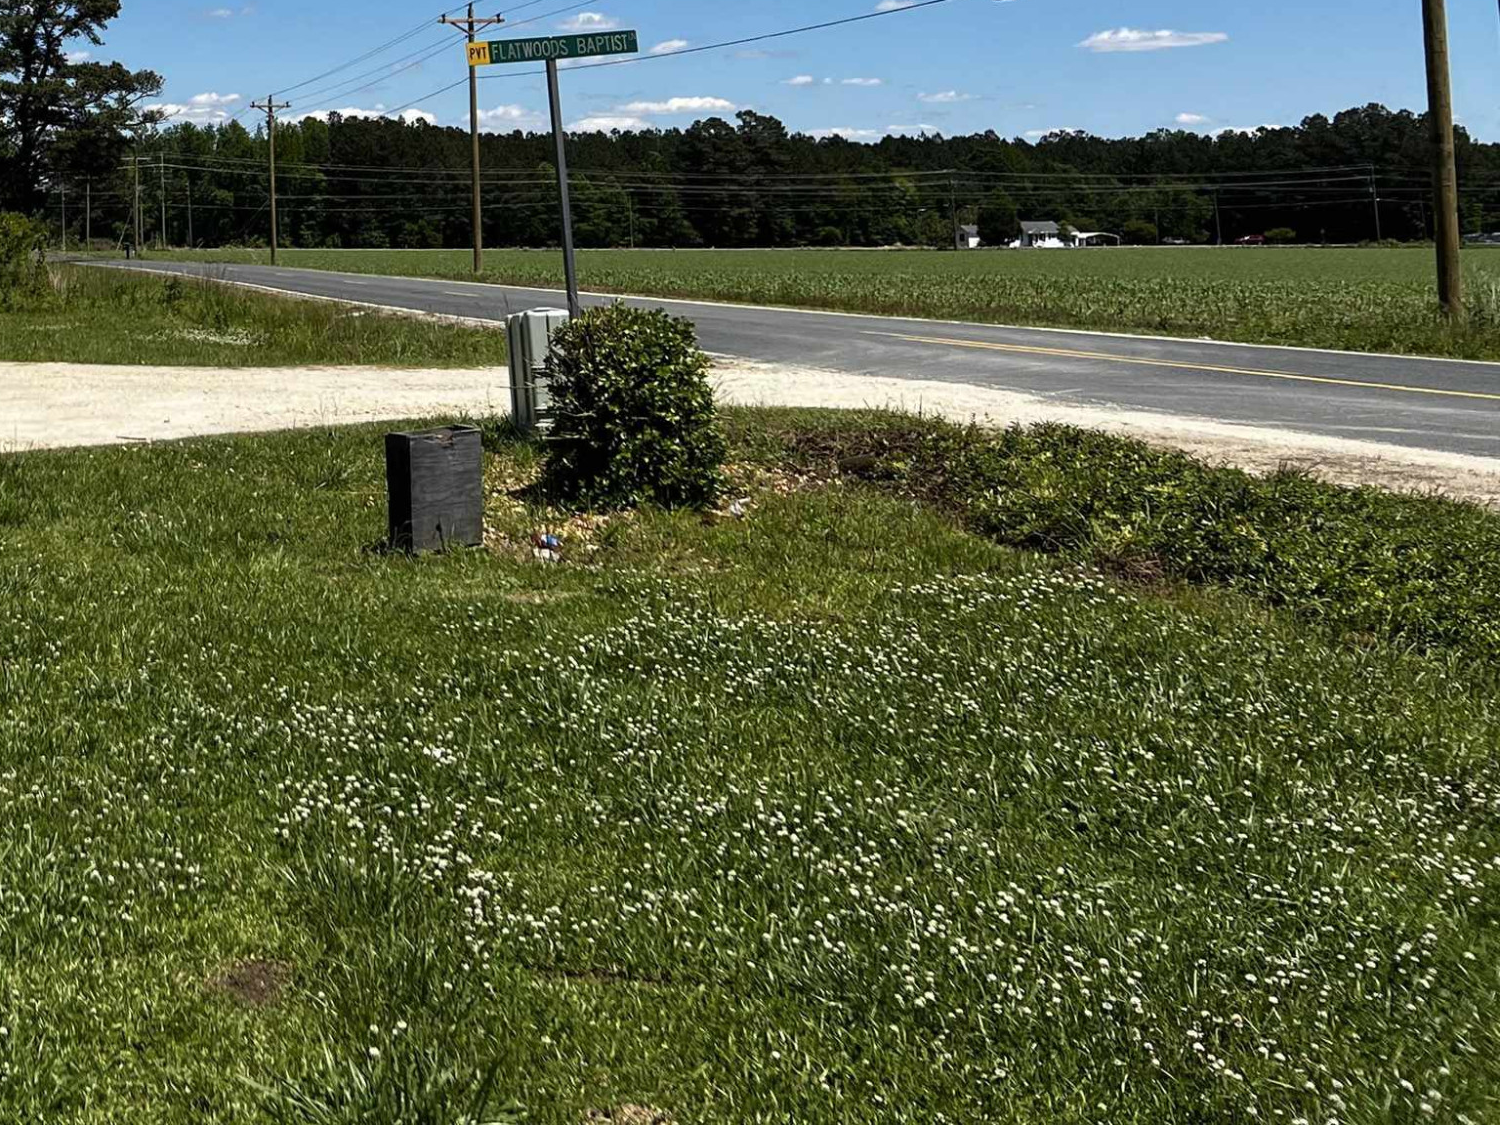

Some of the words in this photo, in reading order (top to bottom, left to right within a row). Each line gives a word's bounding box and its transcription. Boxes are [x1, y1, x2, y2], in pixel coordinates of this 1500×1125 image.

[468, 47, 487, 60] PVT
[492, 39, 569, 60] FLATWOODS
[576, 33, 628, 53] BAPTIST
